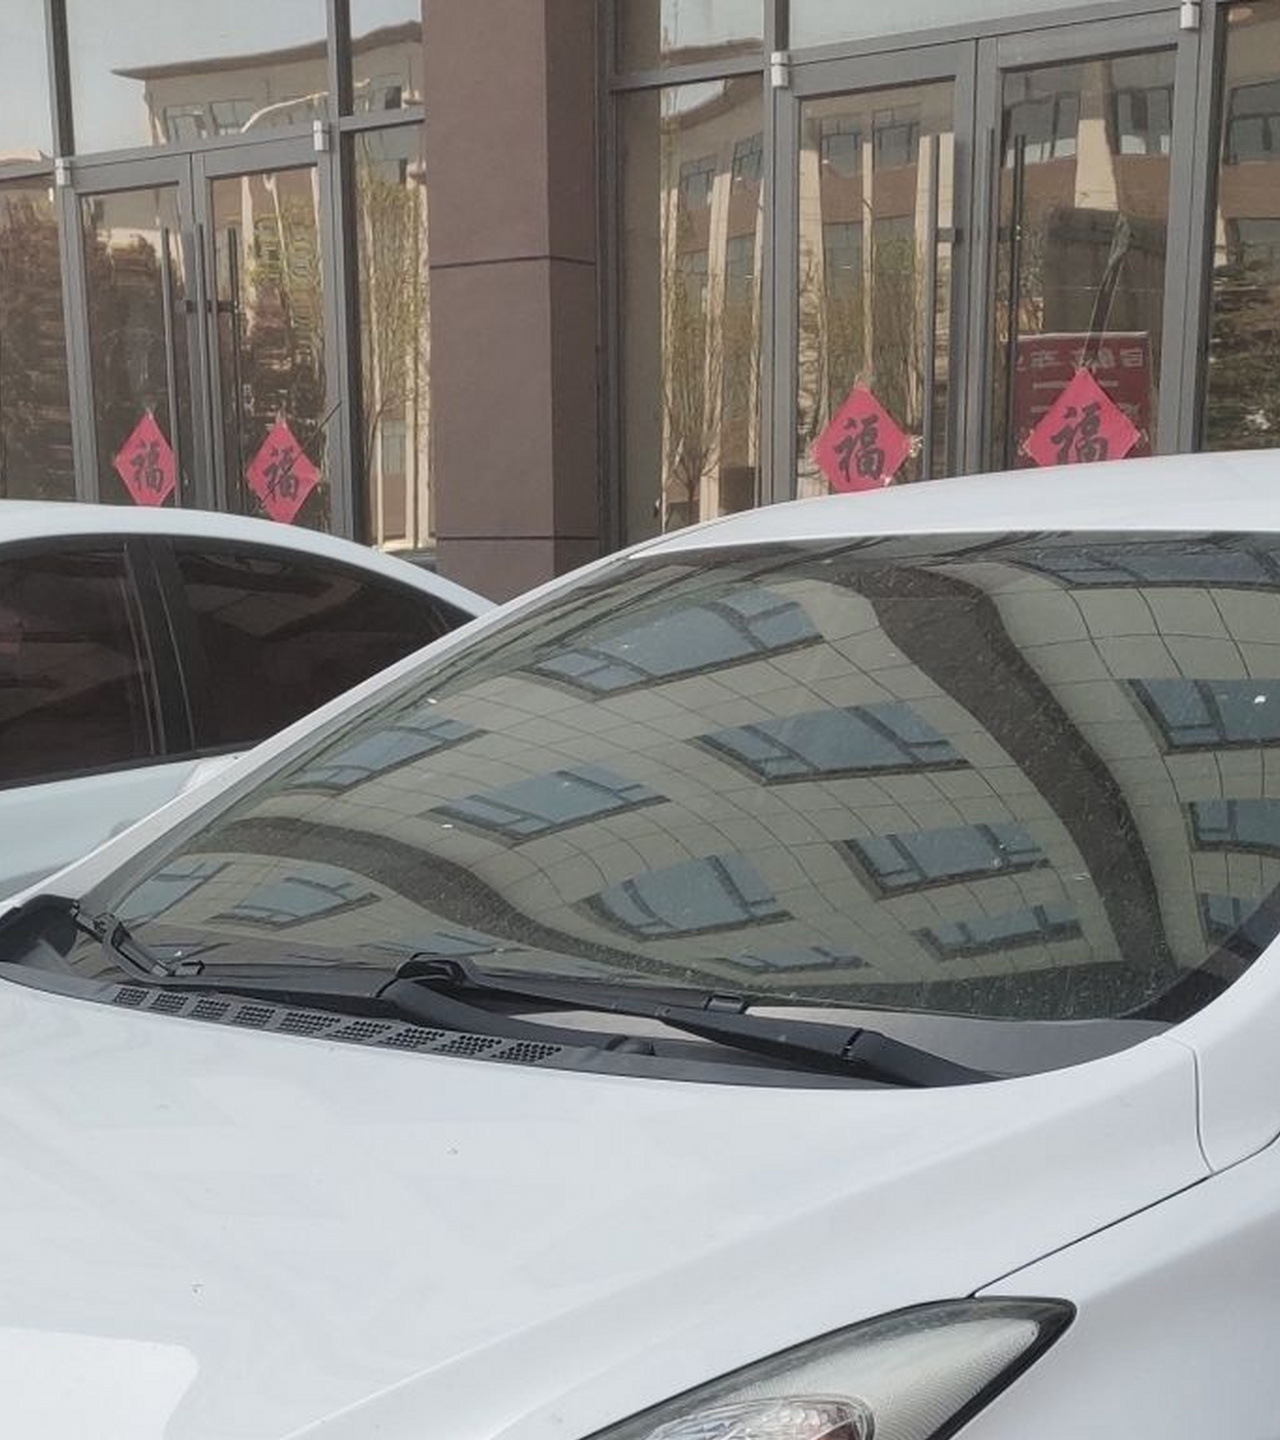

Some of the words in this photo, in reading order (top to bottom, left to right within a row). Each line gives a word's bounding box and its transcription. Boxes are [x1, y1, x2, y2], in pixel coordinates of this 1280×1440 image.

[833, 414, 885, 482] 福
[1052, 403, 1108, 465] 福
[131, 440, 163, 493] 福
[263, 448, 299, 502] 福
